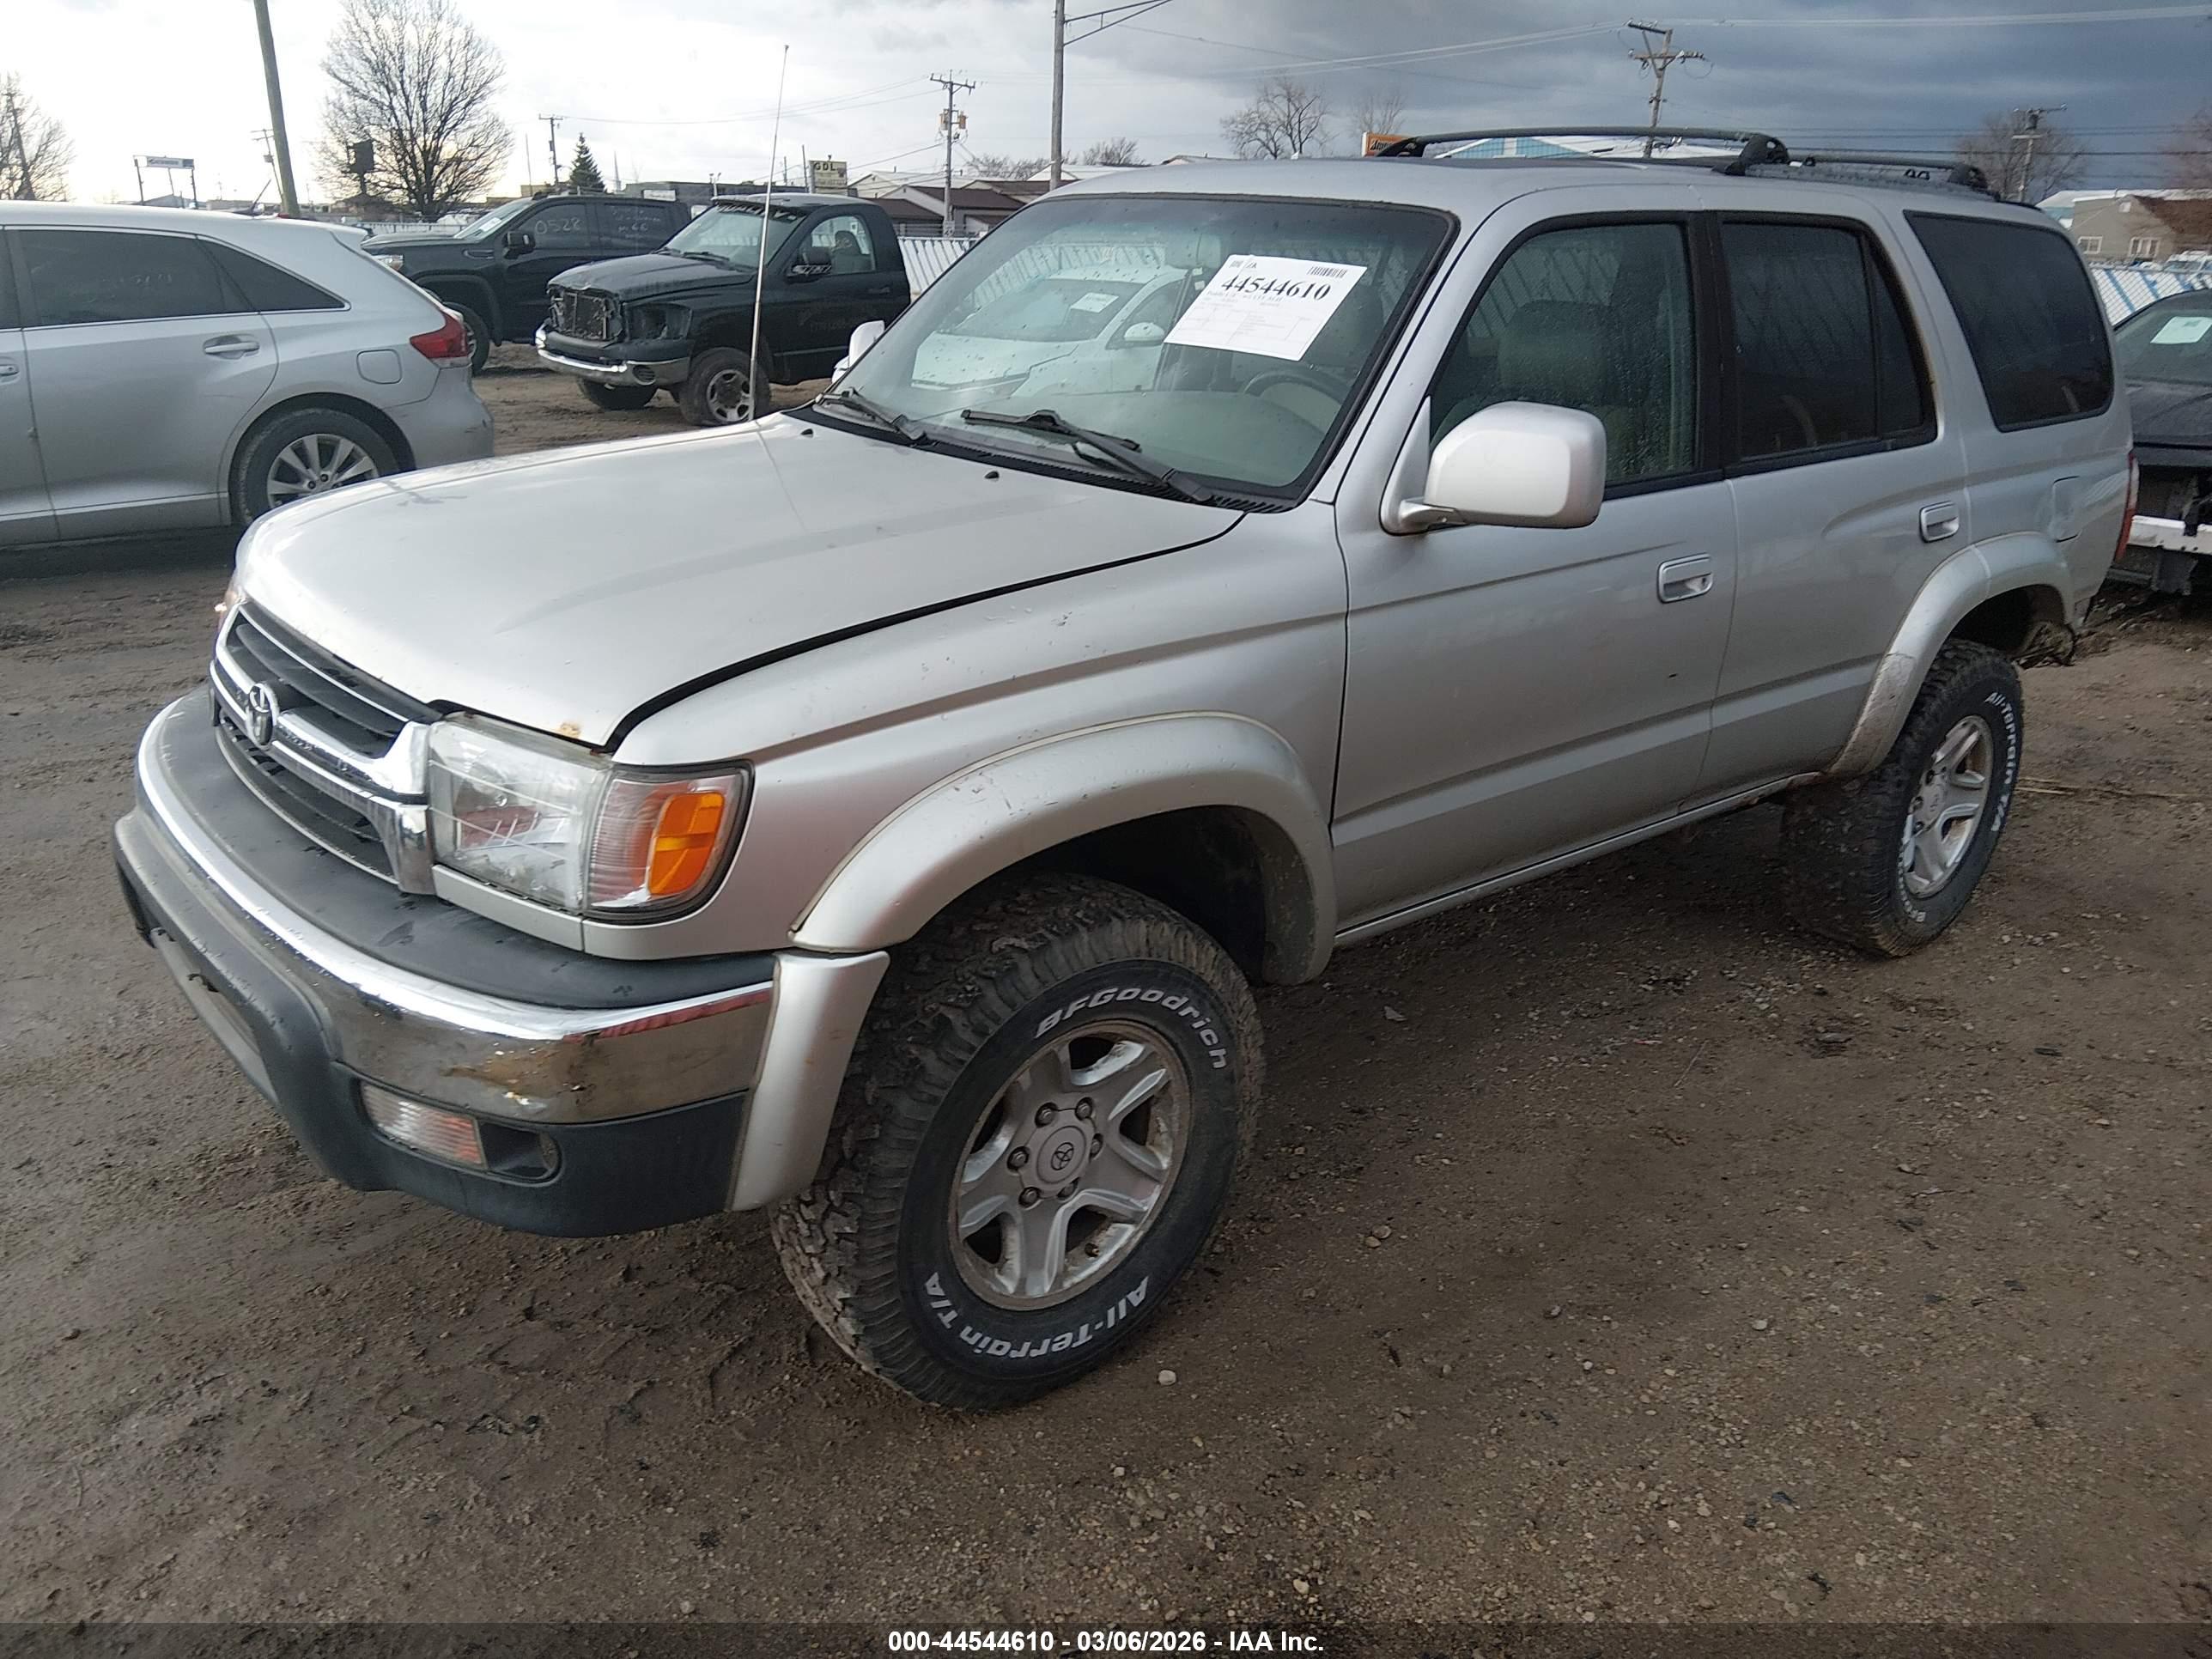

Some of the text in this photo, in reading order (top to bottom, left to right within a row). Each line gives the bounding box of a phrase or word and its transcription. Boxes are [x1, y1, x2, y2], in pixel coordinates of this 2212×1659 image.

[1222, 275, 1330, 301] 44544610
[1036, 988, 1227, 1069] BFGoodrich
[961, 1275, 1150, 1359] All-Terrain
